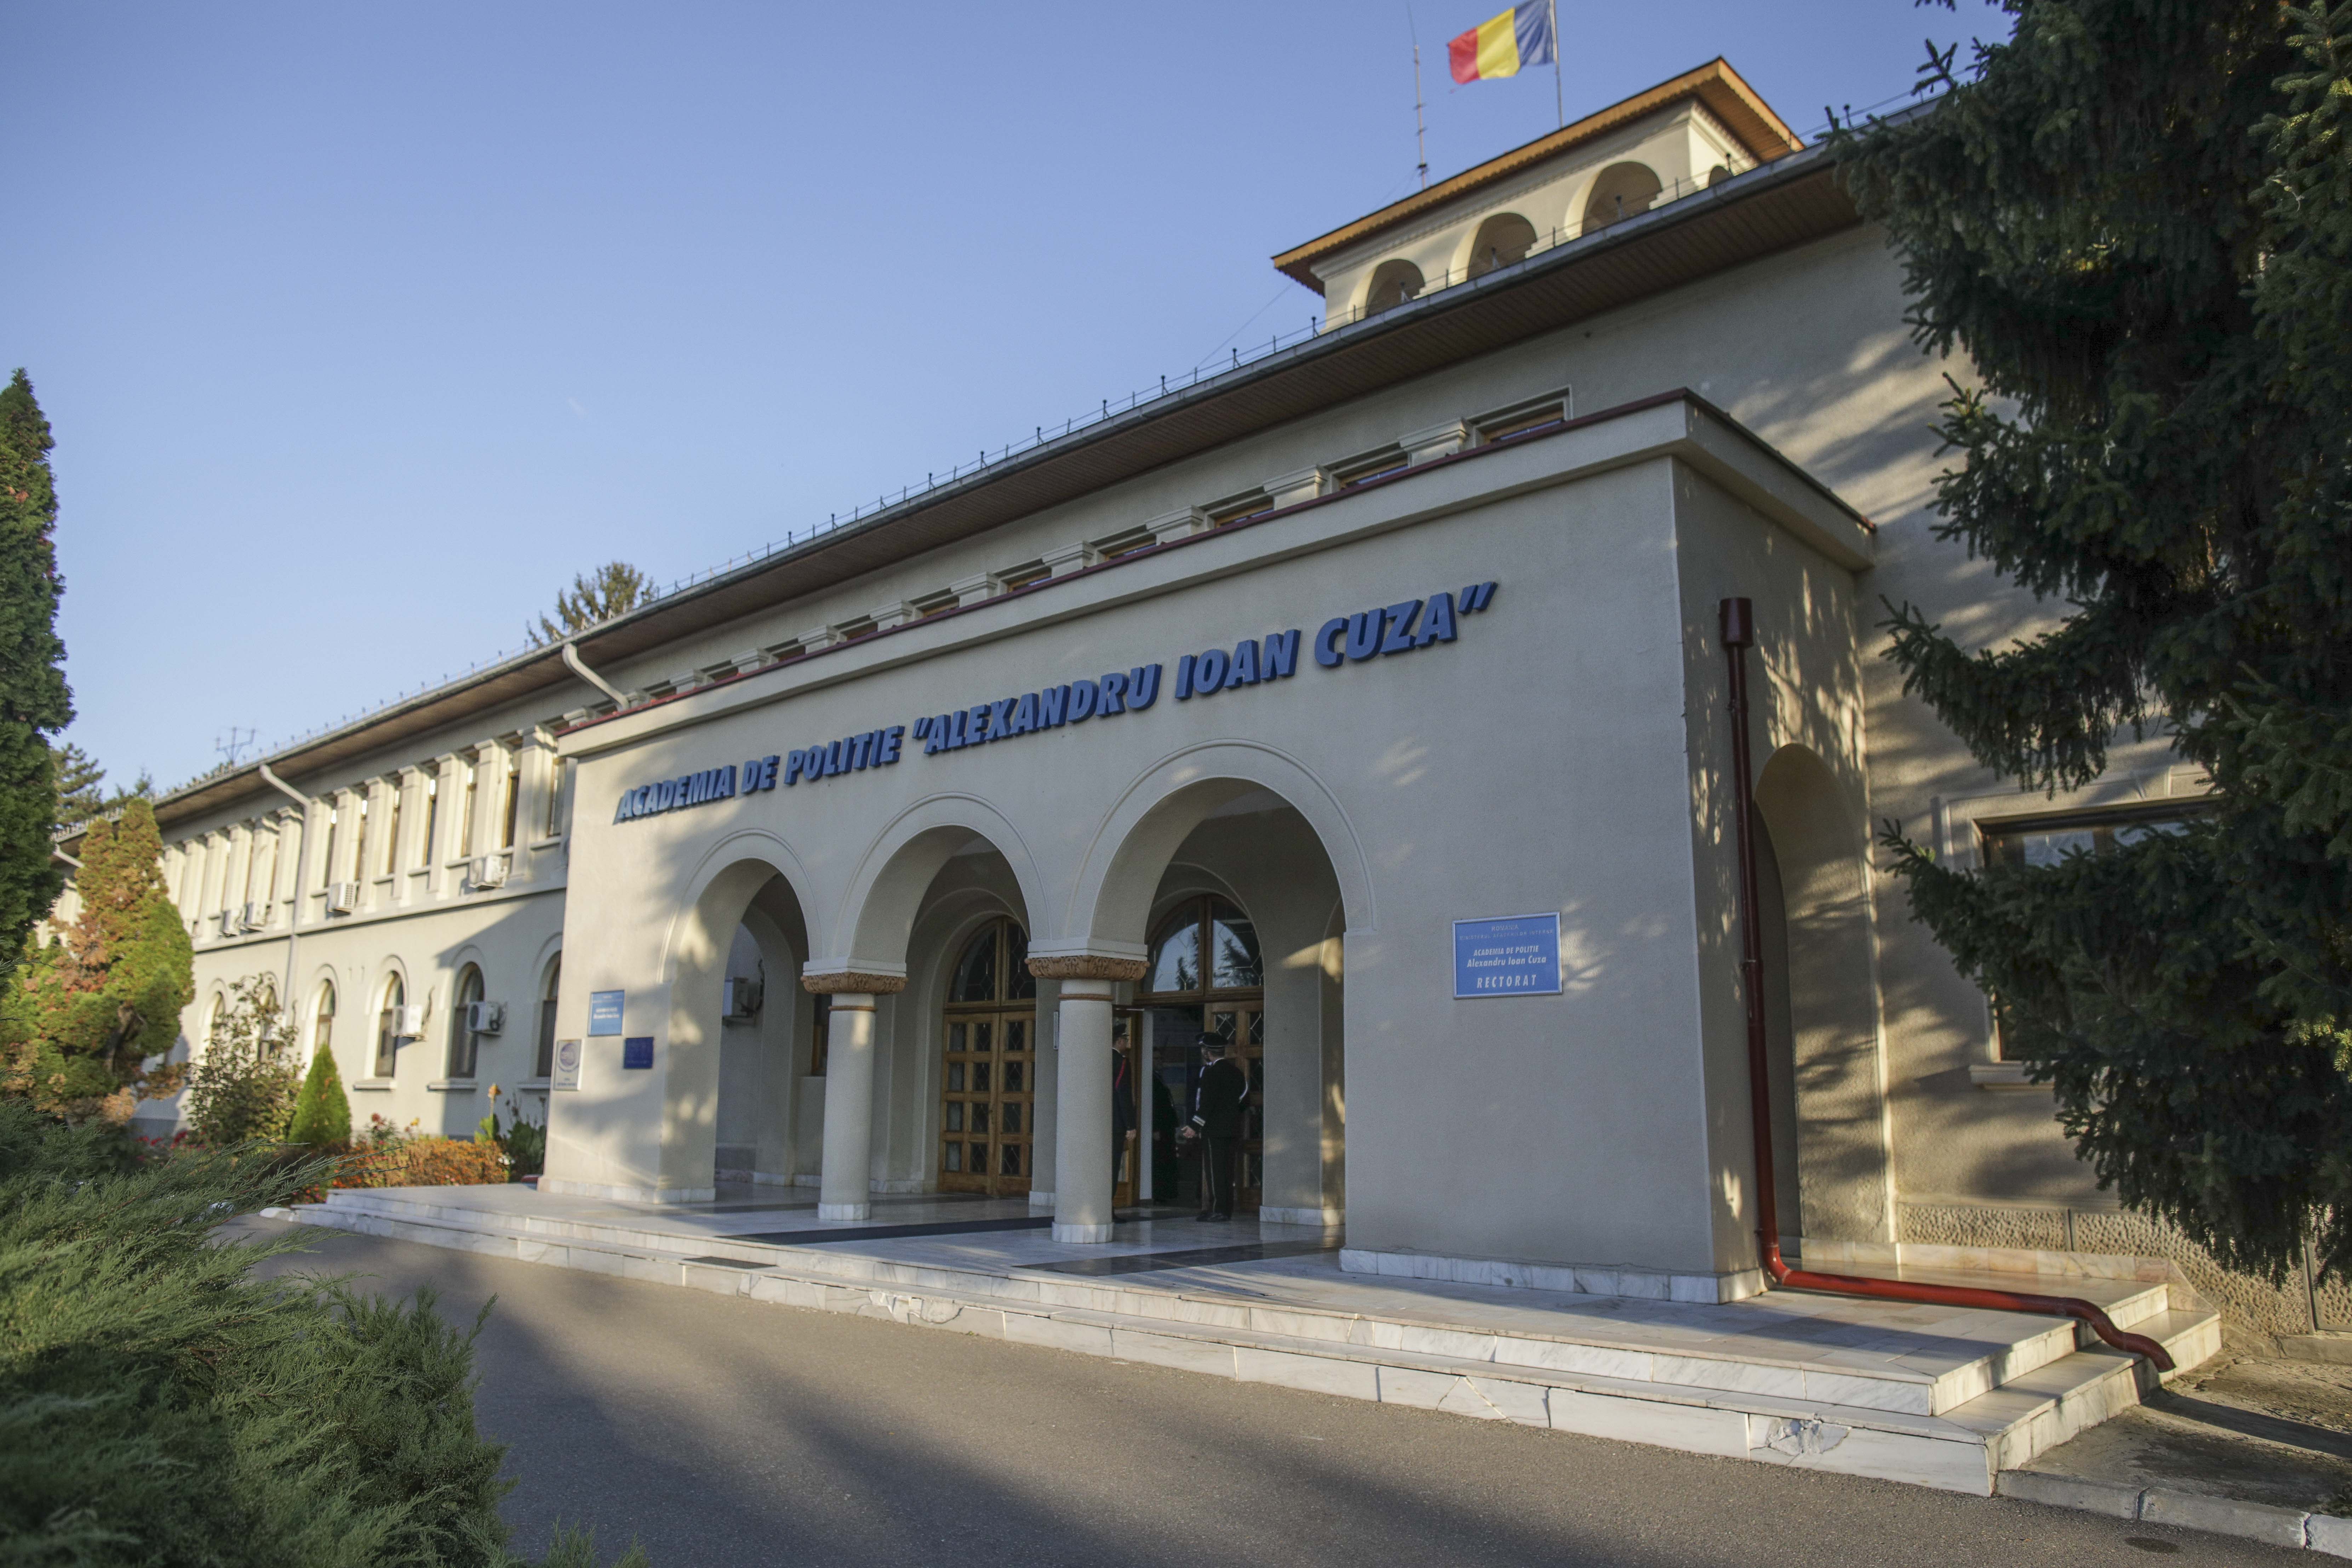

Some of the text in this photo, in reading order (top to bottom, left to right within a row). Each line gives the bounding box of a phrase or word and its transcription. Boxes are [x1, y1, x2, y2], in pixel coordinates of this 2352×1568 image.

[614, 582, 1498, 823] ACADEMIA DE POLITIE "ALEXANDRU IOAN CUZA"
[1516, 945, 1539, 954] POLITIE
[1467, 955, 1546, 967] Alexandru Ioan Cuza
[1477, 974, 1536, 988] RECTORAT
